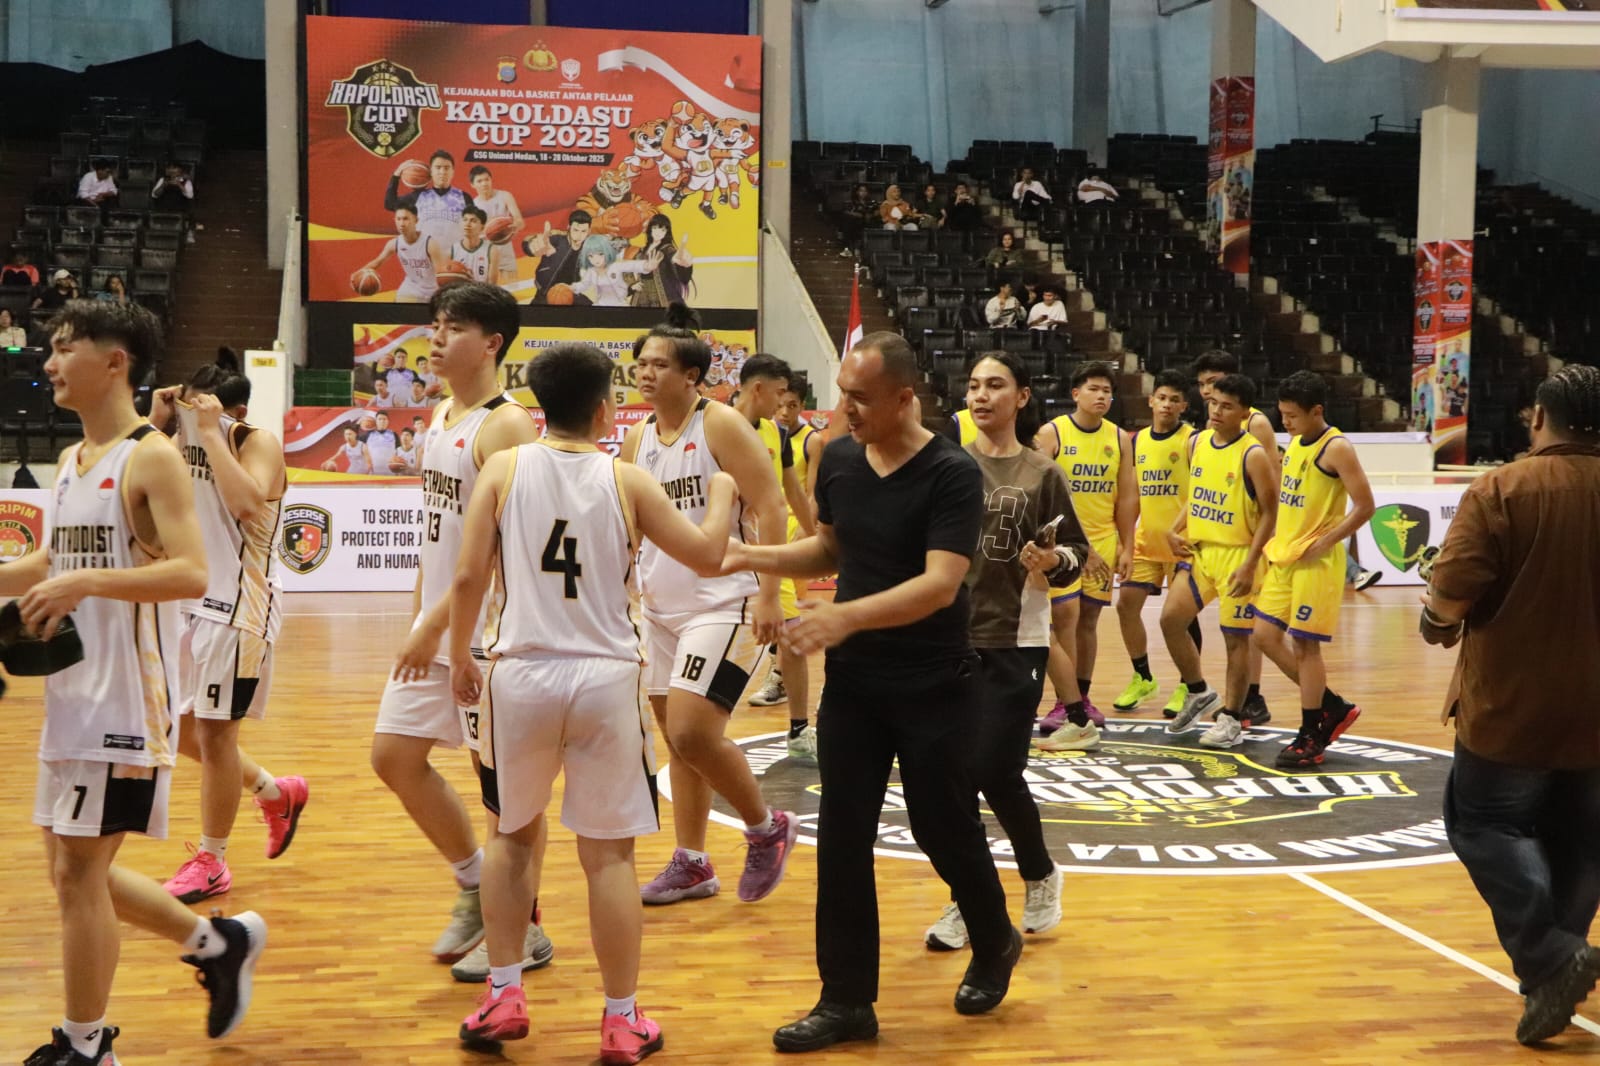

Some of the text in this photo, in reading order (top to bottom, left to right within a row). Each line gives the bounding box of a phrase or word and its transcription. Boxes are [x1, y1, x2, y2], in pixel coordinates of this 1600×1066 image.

[443, 87, 634, 102] KEJUARAAN BOLA BASKET ANTAR PELAJAR
[363, 105, 408, 123] CUP
[445, 101, 633, 128] KAPOLDASU
[373, 123, 396, 132] 2025
[468, 122, 611, 148] CUP 2025
[607, 341, 636, 350] BASKE
[1064, 446, 1077, 455] 16
[1072, 464, 1109, 477] ONLY
[1142, 470, 1172, 482] ONLY
[1069, 480, 1115, 493] SOIKI
[1193, 487, 1228, 506] ONLY
[362, 509, 376, 524] TO
[379, 509, 413, 524] SERVE
[1190, 503, 1235, 525] SOIKI
[428, 511, 442, 542] 13
[977, 486, 1029, 562] 3
[341, 531, 390, 546] PROTECT
[393, 531, 415, 546] FOR
[357, 554, 420, 569] AND HUMA
[541, 519, 582, 599] 4
[1233, 605, 1254, 619] 18
[1295, 605, 1312, 622] 9
[681, 654, 706, 682] 18
[207, 684, 221, 708] 9
[464, 711, 479, 740] 13
[73, 785, 88, 820] 7
